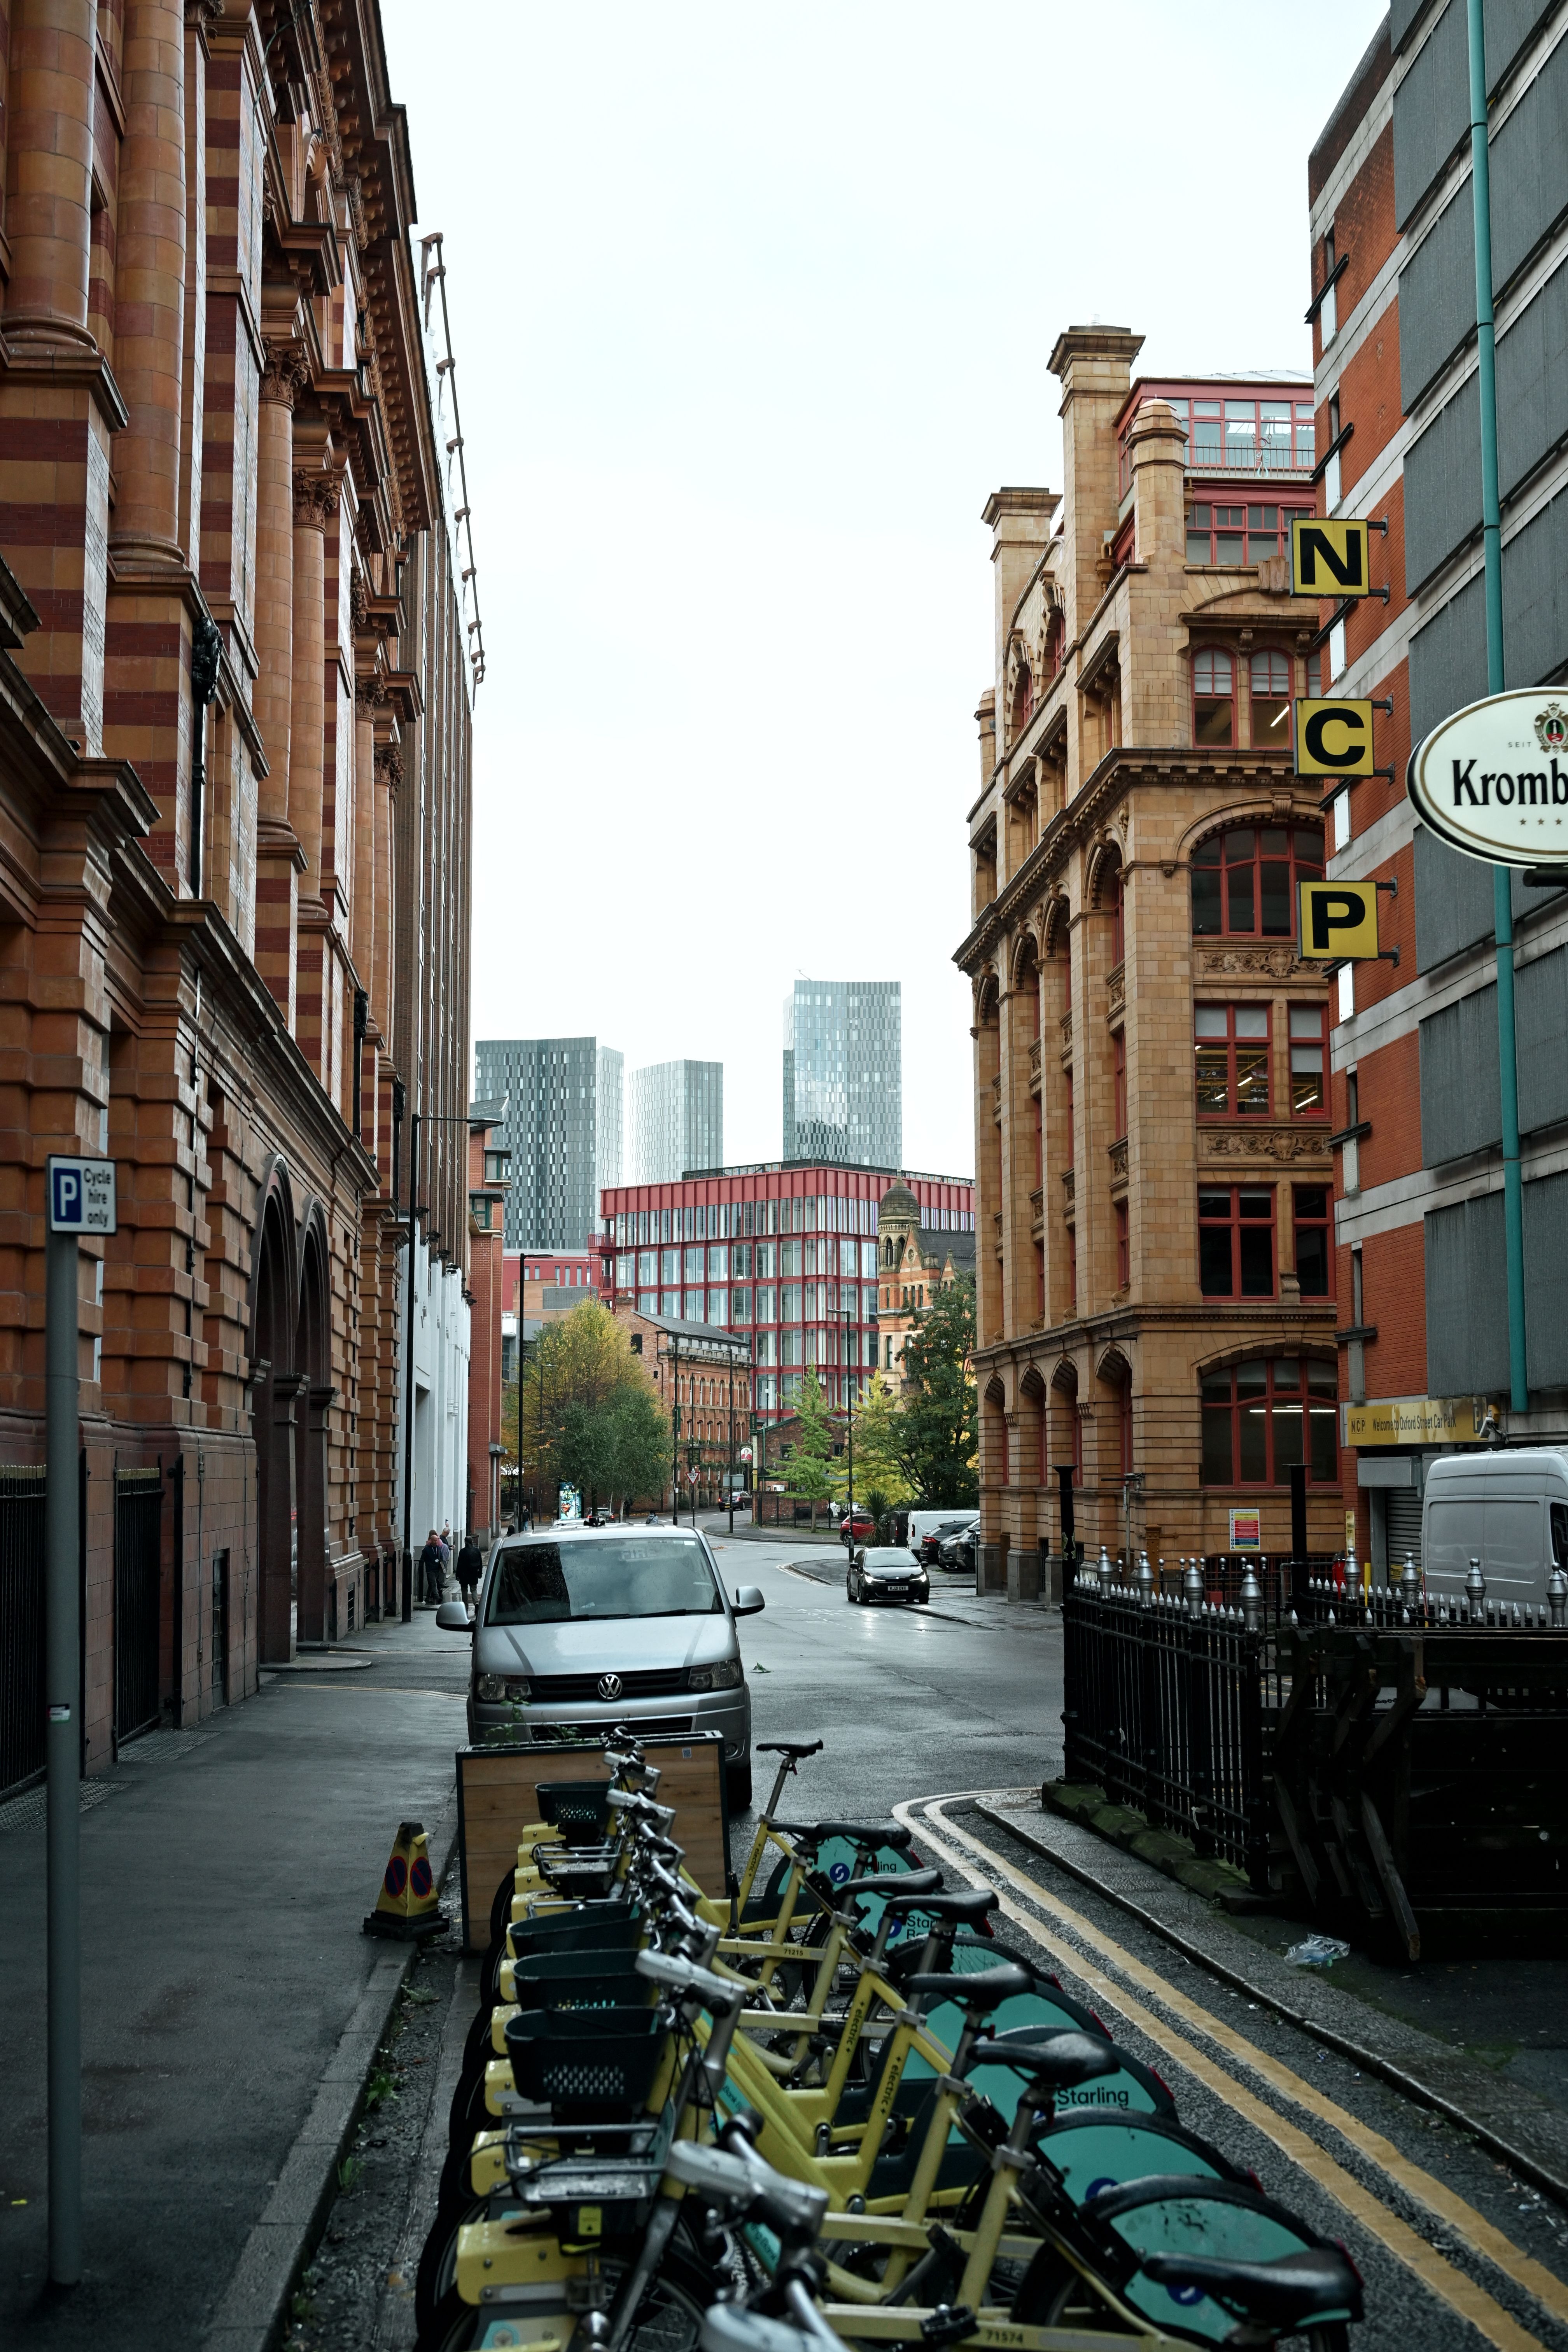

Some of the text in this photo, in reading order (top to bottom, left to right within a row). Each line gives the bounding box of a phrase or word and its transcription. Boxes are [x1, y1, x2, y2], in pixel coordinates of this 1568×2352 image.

[1299, 528, 1362, 586] N
[1305, 708, 1365, 767] C
[1312, 890, 1366, 949] P
[84, 1168, 112, 1186] Cycle
[60, 1175, 78, 1217] P
[88, 1189, 108, 1205] hire
[88, 1210, 108, 1227] only
[1351, 1419, 1365, 1433] NCP
[1372, 1414, 1456, 1432] Welcome to Oxford Street Car Park
[747, 1848, 760, 1871] electric
[848, 2009, 864, 2042] electric
[881, 2063, 902, 2106] electric
[1057, 2086, 1129, 2110] Starling
